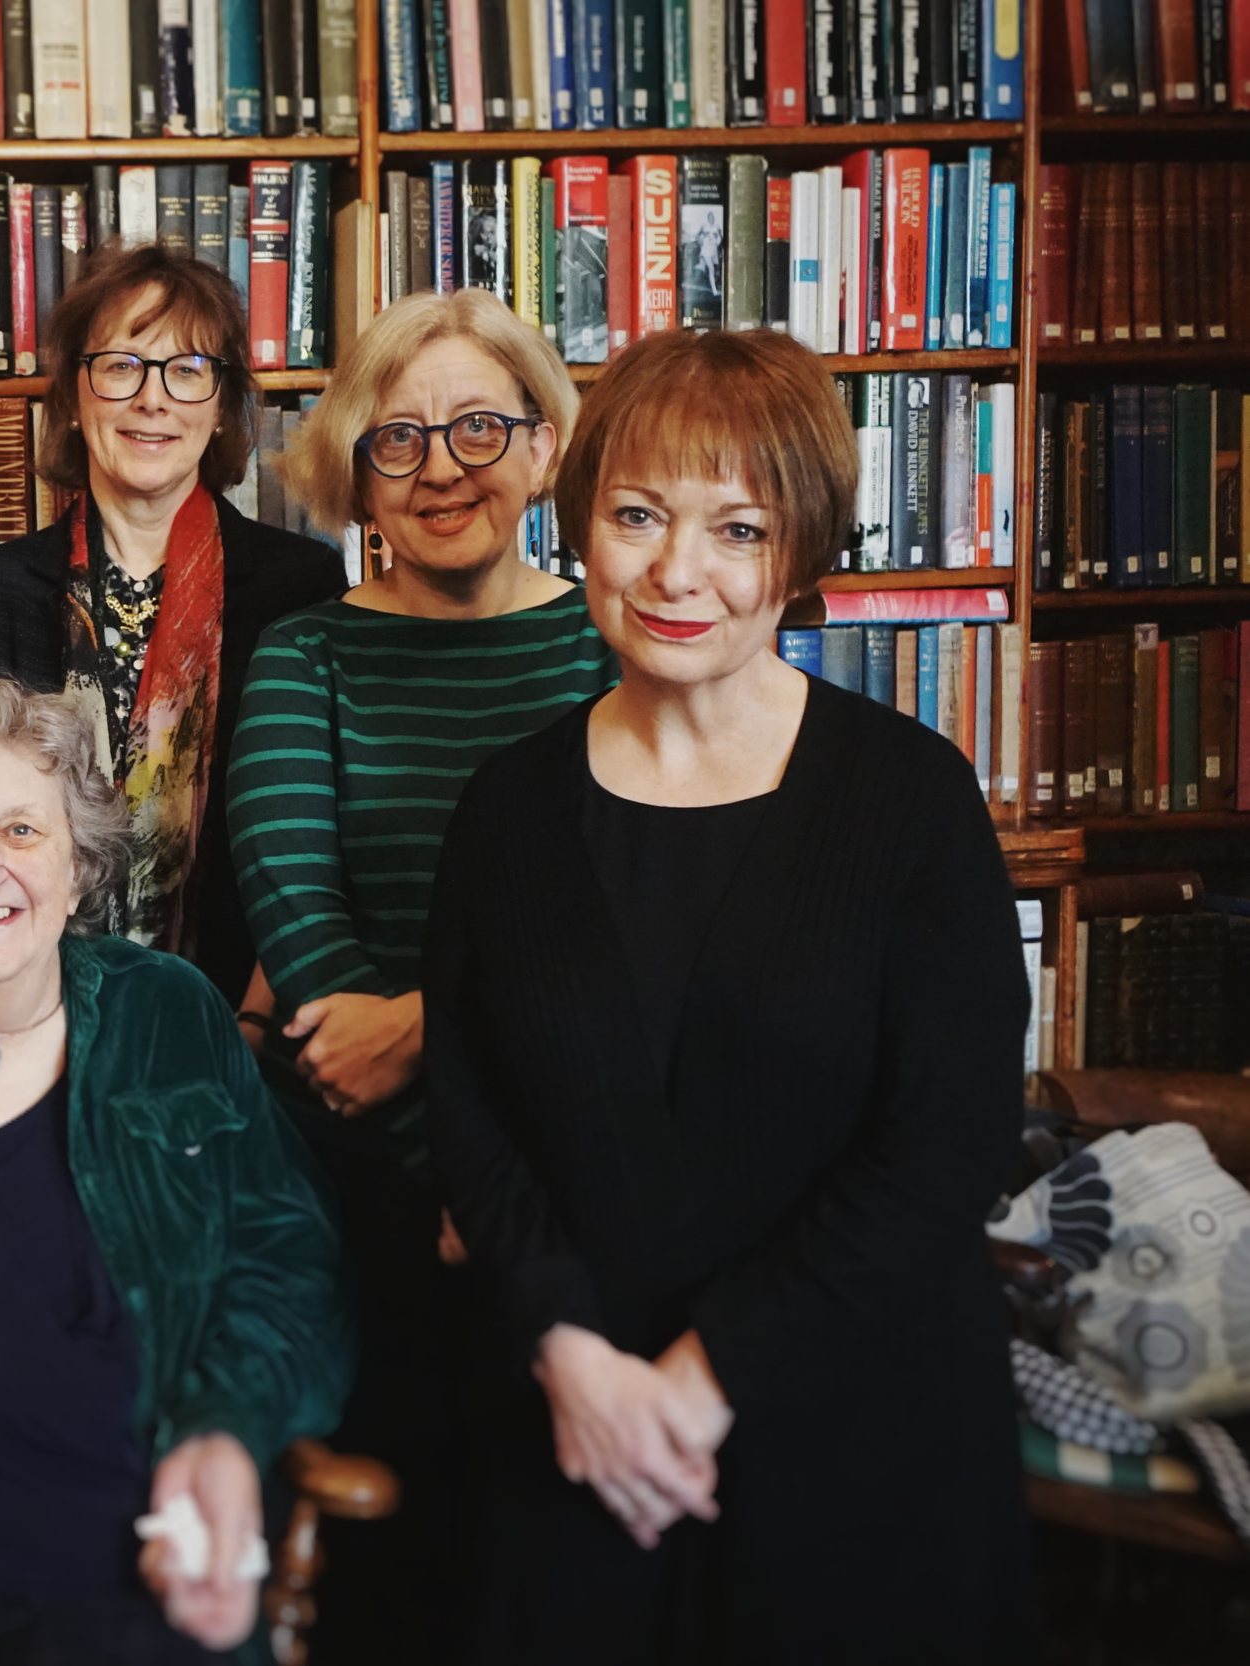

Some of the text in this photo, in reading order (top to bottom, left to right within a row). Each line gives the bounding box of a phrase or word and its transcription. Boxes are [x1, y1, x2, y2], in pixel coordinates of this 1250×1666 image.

[252, 174, 288, 185] HALIFAX
[568, 165, 603, 175] Austerity
[568, 174, 595, 182] Britain
[873, 156, 882, 239] SEPARATE WAYS
[901, 168, 912, 224] WILSON
[911, 167, 921, 228] HAROLD
[526, 172, 535, 314] CONFESSIONS OF AN OPTIMIST
[645, 168, 672, 280] SUEZ
[978, 160, 990, 279] AN AFFAIR OF STATE
[304, 262, 313, 284] ROY
[645, 288, 672, 309] KEITH
[304, 286, 314, 330] JENKINS
[955, 395, 968, 455] Prudence
[907, 410, 918, 513] DAVID BLUNKETT
[917, 410, 929, 535] THE BLUNKETT TAPES
[1040, 430, 1050, 542] ADAM NICOLSON
